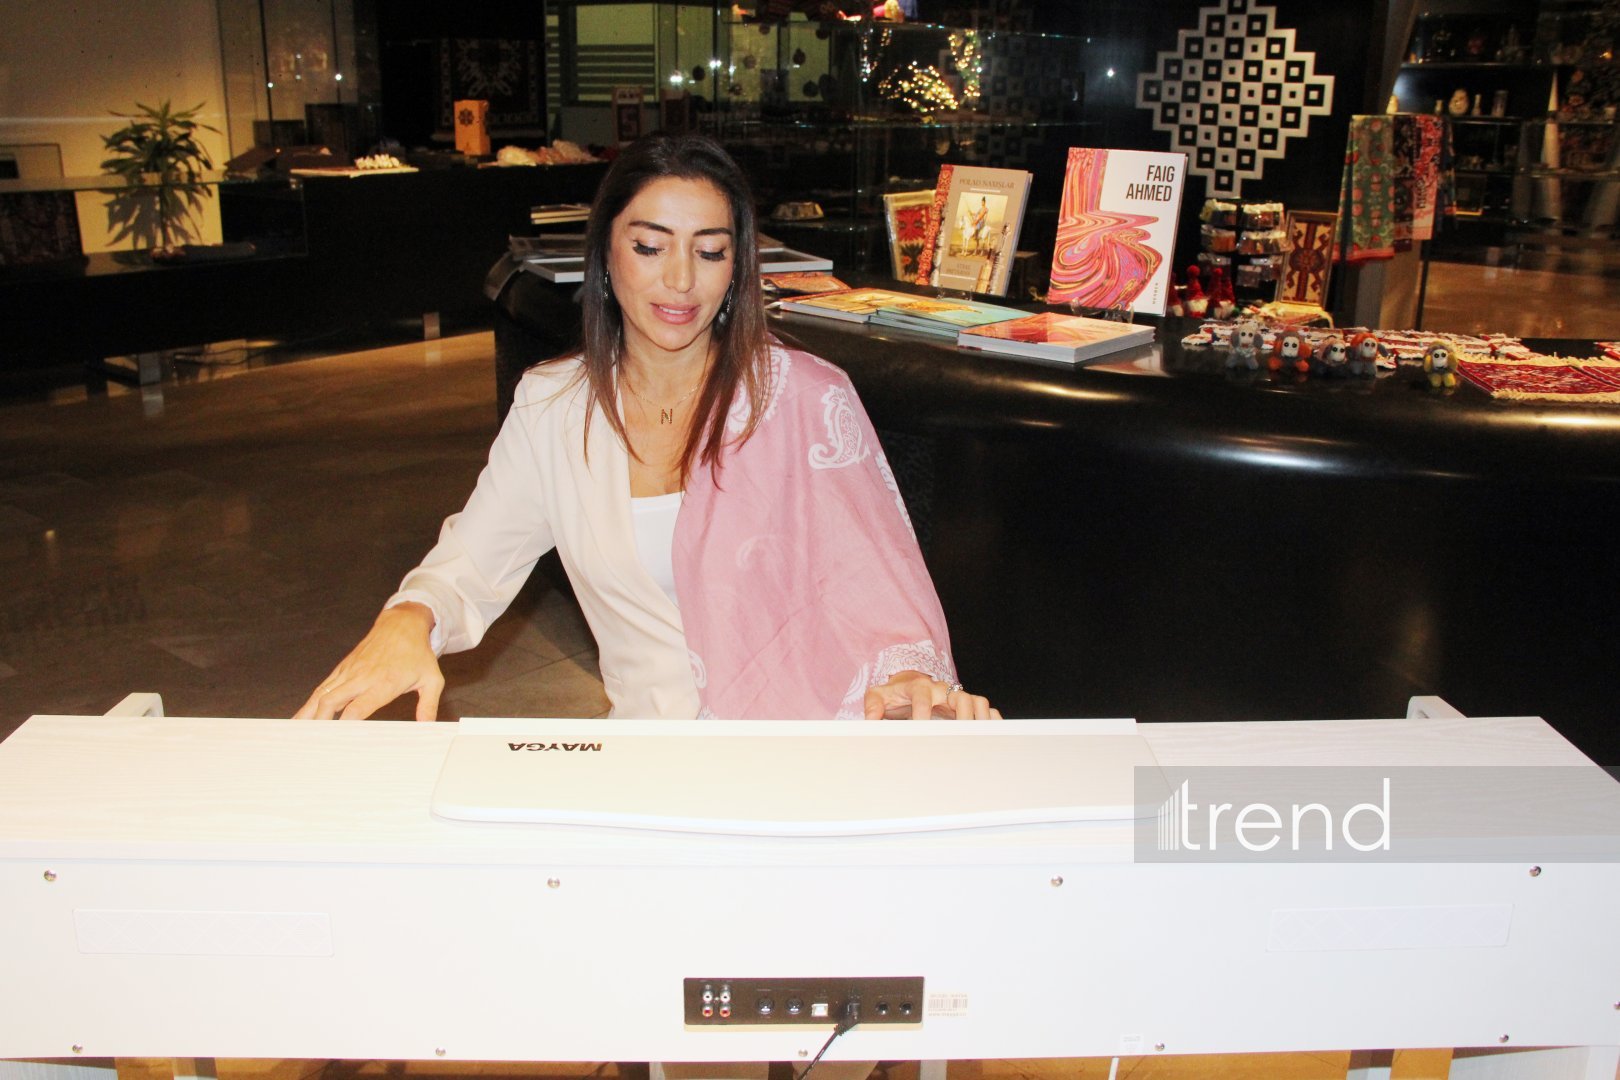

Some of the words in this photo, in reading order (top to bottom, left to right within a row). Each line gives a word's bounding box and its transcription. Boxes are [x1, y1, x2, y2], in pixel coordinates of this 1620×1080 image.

[1146, 164, 1176, 183] FAIG
[1125, 183, 1173, 202] AHMED
[661, 408, 673, 425] N
[507, 742, 603, 752] MAYGA
